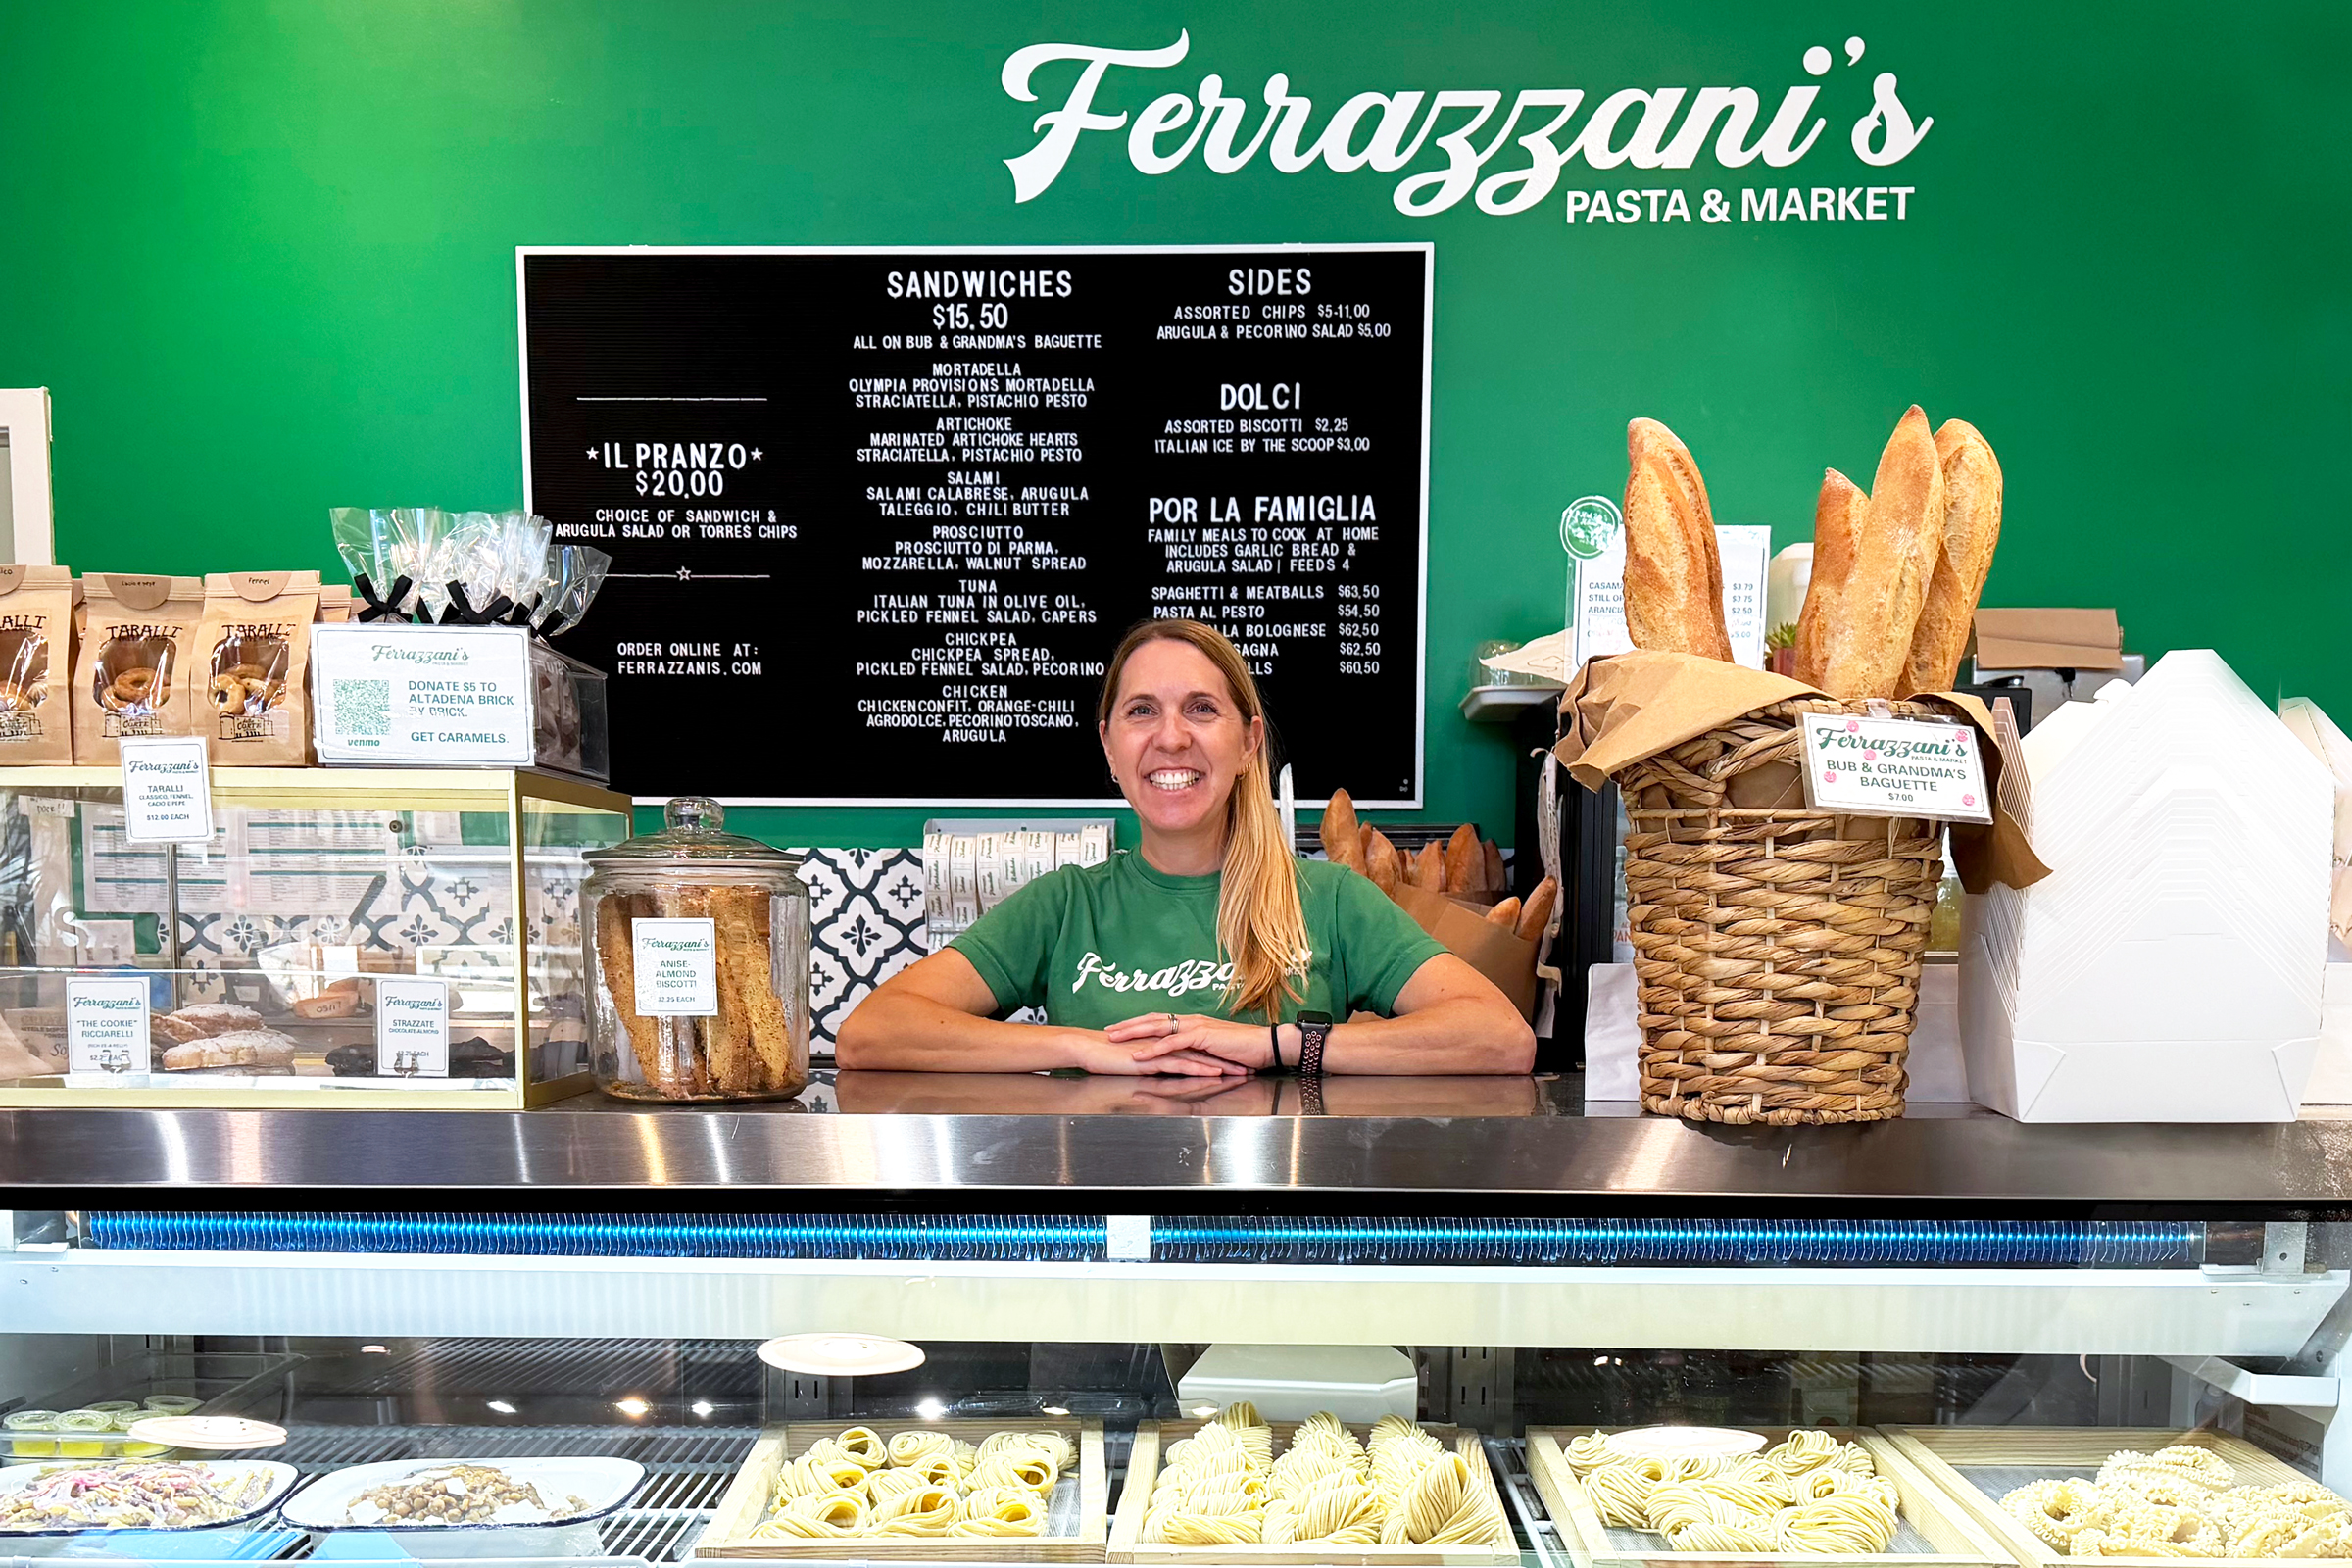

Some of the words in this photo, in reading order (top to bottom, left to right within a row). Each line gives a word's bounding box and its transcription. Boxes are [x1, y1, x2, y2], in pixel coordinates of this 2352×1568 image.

[1002, 27, 1934, 218] Ferrazzani's
[1566, 190, 1692, 223] PASTA
[1699, 189, 1732, 221] &
[1740, 186, 1916, 221] MARKET
[886, 270, 1072, 299] SANDWICHES
[1228, 268, 1311, 296] SIDES
[932, 302, 1008, 331] $15.50
[1173, 305, 1251, 320] ASSORTED
[1261, 304, 1306, 319] CHIPS
[1156, 324, 1217, 340] ARUGULA
[1236, 323, 1308, 339] PECORINO
[1311, 323, 1354, 339] SALAD
[1357, 322, 1392, 338] $5.00
[853, 335, 878, 350] ALL
[882, 334, 902, 350] ON
[906, 335, 934, 350] BUB
[952, 334, 1027, 350] GRANDMA'S
[1034, 333, 1102, 349] BAGUETTE
[932, 362, 1022, 377] MORTADELLA
[848, 377, 907, 393] OLYMPIA
[912, 377, 1000, 393] PROVISIONS
[1005, 377, 1095, 393] MORTADELLA
[855, 393, 962, 409] STRACIATELLA,
[967, 393, 1039, 409] PISTACHIO
[1045, 393, 1088, 408] PESTO
[1220, 381, 1301, 412] DOLCI
[935, 416, 1012, 432] ARTICHOKE
[1164, 418, 1235, 434] ASSORTED
[1239, 418, 1302, 433] BISCOTTI
[1314, 417, 1349, 433] $2.25
[869, 432, 945, 448] MARINATED
[952, 432, 1024, 447] ARTICHOKE
[1029, 432, 1079, 447] HEARTS
[1154, 438, 1208, 454] ITALIAN
[1212, 438, 1234, 454] ICE
[1240, 438, 1256, 453] BY
[1262, 437, 1286, 453] THE
[1291, 437, 1335, 452] SCOOP
[1336, 436, 1371, 452] $3.00
[603, 442, 629, 469] IL
[635, 442, 748, 470] PRANZO
[857, 447, 956, 463] STRACIATELLA,
[962, 447, 1035, 463] PISTACHIO
[1040, 447, 1083, 463] PESTO
[635, 469, 724, 500] $20.00
[947, 470, 1000, 486] SALAMI
[866, 486, 921, 501] SALAMI
[927, 486, 1014, 502] CALABRESE,
[1020, 486, 1089, 501] ARUGULA
[595, 508, 650, 523] CHOICE
[657, 509, 675, 523] OF
[685, 509, 760, 524] SANDWICH
[878, 502, 958, 516] TALEGGIO,
[965, 502, 1007, 516] CHILI
[1012, 502, 1070, 516] BUTTER
[1149, 497, 1198, 524] POR
[1210, 496, 1242, 523] LA
[1254, 494, 1377, 523] FAMIGLIA
[555, 523, 616, 538] ARUGULA
[621, 523, 665, 539] SALAD
[671, 524, 691, 539] OR
[698, 521, 752, 539] TORRES
[758, 524, 798, 539] CHIPS
[932, 525, 1024, 540] PROSCIUTTO
[1148, 528, 1197, 543] FAMILY
[1202, 527, 1247, 543] MEALS
[1250, 527, 1268, 542] TO
[1271, 526, 1307, 542] COOK
[1316, 526, 1333, 541] AT
[1342, 526, 1379, 541] HOME
[895, 540, 983, 556] PROSCIUTTO
[987, 541, 1001, 556] DI
[1008, 540, 1059, 556] PARMA,
[1164, 543, 1229, 559] INCLUDES
[1234, 543, 1284, 558] GARLIC
[1292, 542, 1340, 560] BREAD
[861, 556, 959, 570] MOZZARELLA,
[965, 556, 1022, 571] WALNUT
[1031, 556, 1087, 570] SPREAD
[1166, 559, 1227, 574] ARUGULA
[1231, 558, 1273, 573] SALAD
[1290, 557, 1336, 572] FEEDS
[958, 579, 998, 594] TUNA
[1151, 585, 1224, 601] SPAGHETTI
[1246, 585, 1325, 600] MEATBALLS
[1338, 584, 1380, 600] $63.50
[874, 594, 928, 609] ITALIAN
[937, 594, 976, 609] TUNA
[982, 594, 998, 610] IN
[1004, 594, 1048, 609] OLIVE
[1054, 594, 1086, 609] OIL,
[858, 609, 919, 624] PICKLED
[925, 609, 979, 624] FENNEL
[986, 609, 1036, 624] SALAD,
[1041, 610, 1097, 624] CAPERS
[1152, 605, 1195, 620] PASTA
[1200, 605, 1217, 619] AL
[1222, 605, 1265, 619] PESTO
[1337, 603, 1380, 618] $54.50
[106, 625, 183, 639] TARALLI
[221, 623, 296, 639] TARALLI
[1245, 622, 1327, 638] BOLOGNESE
[945, 632, 1017, 647] CHICKPEA
[371, 645, 469, 664] Ferrazzani's
[616, 642, 662, 657] ORDER
[669, 642, 722, 657] ONLINE
[733, 643, 759, 658] AT:
[911, 647, 983, 662] CHICKPEA
[993, 647, 1055, 662] SPREAD,
[1339, 641, 1381, 657] $62.50
[857, 662, 916, 676] PICKLED
[921, 662, 974, 676] FENNEL
[981, 662, 1029, 676] SALAD,
[1032, 662, 1105, 677] PECORINO
[409, 680, 459, 691] DONATE
[463, 682, 476, 692] $5
[479, 682, 496, 692] TO
[942, 684, 1008, 699] CHICKEN
[409, 694, 474, 705] ALTADENA
[479, 695, 514, 705] BRICK
[348, 738, 380, 747] venmo
[411, 732, 435, 742] GET
[439, 733, 509, 744] CARAMELS.
[942, 728, 1007, 743] ARUGULA
[1816, 727, 1968, 758] Ferrazzani's
[129, 760, 199, 773] Ferrazzani's
[1827, 760, 1857, 772] BUB
[1861, 763, 1873, 773] &
[1877, 764, 1967, 779] GRANDMA'S
[1860, 776, 1938, 792] BAGUETTE
[1888, 792, 1914, 802] $7.00
[642, 937, 709, 952] Ferrazzani's
[74, 997, 141, 1009] Ferrazzani's
[385, 996, 442, 1009] Ferrazzani's
[393, 1019, 434, 1028] STRAZZATE
